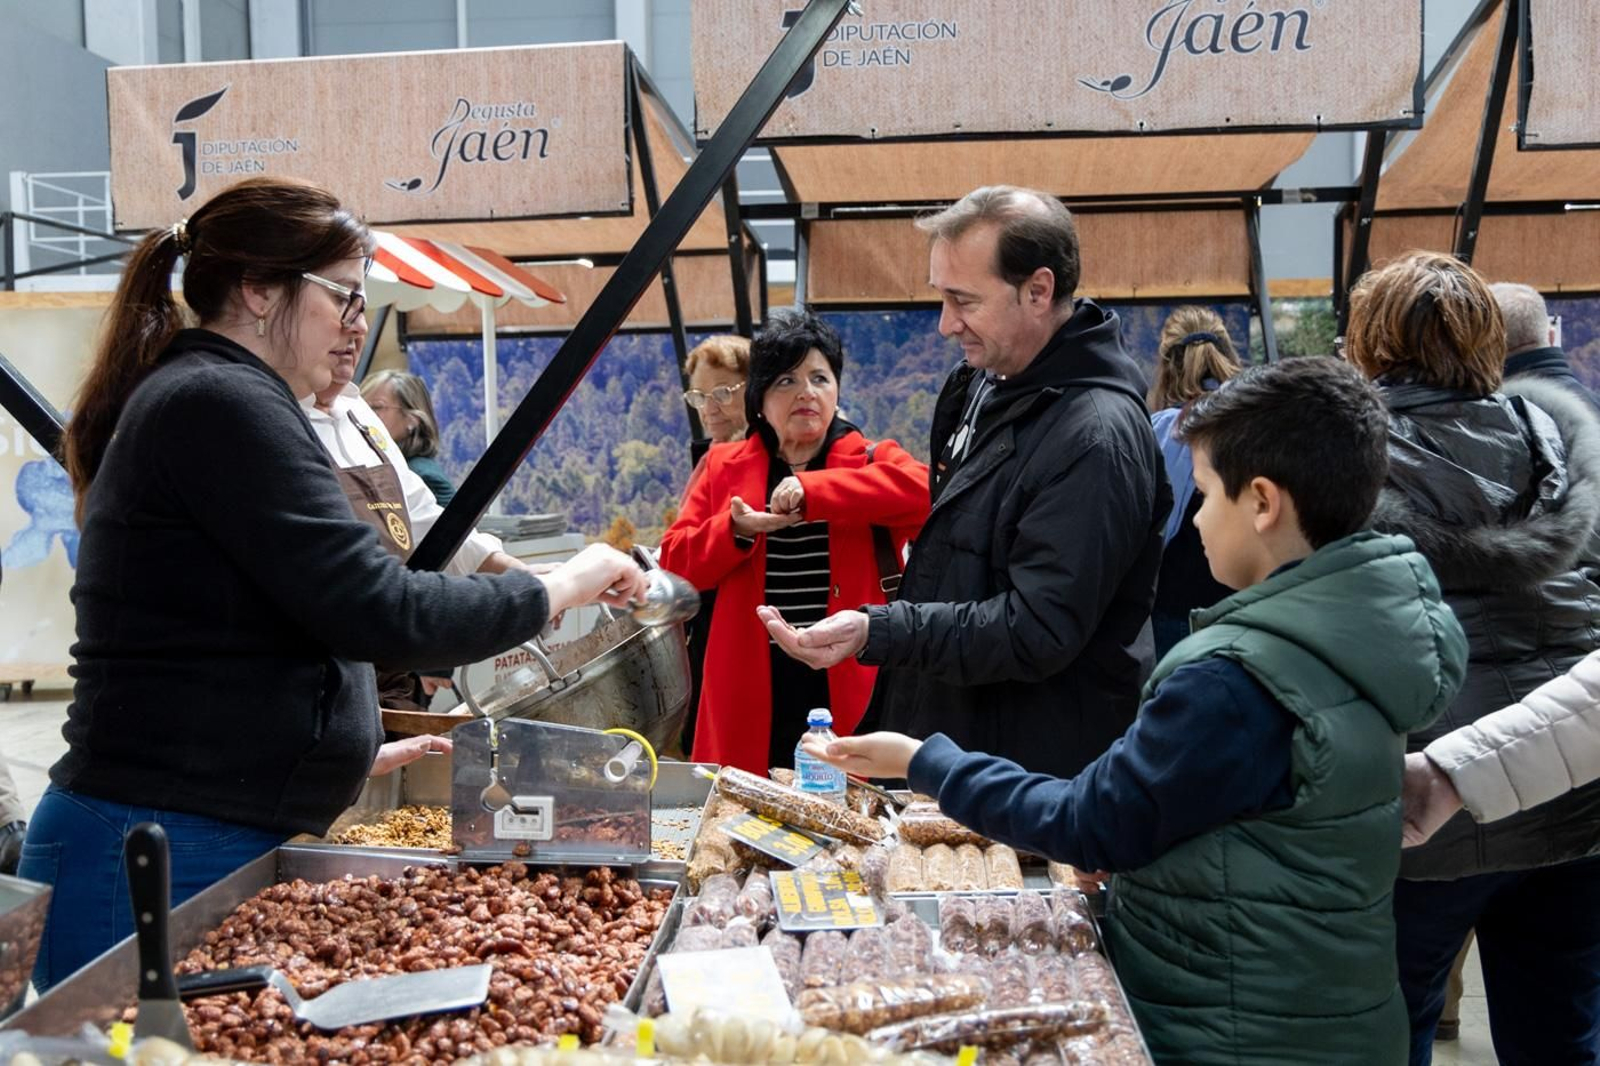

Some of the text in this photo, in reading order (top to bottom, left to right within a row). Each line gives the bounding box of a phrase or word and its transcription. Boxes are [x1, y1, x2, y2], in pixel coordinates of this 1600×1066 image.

[827, 19, 957, 42] DIPUTACIÓN
[823, 46, 911, 67] DE JAÉN
[448, 97, 536, 123] Degusta
[202, 138, 298, 155] DIPUTACIÓN
[202, 159, 265, 174] DE JAÉN
[431, 121, 549, 194] Jaén
[494, 651, 538, 671] PATATA
